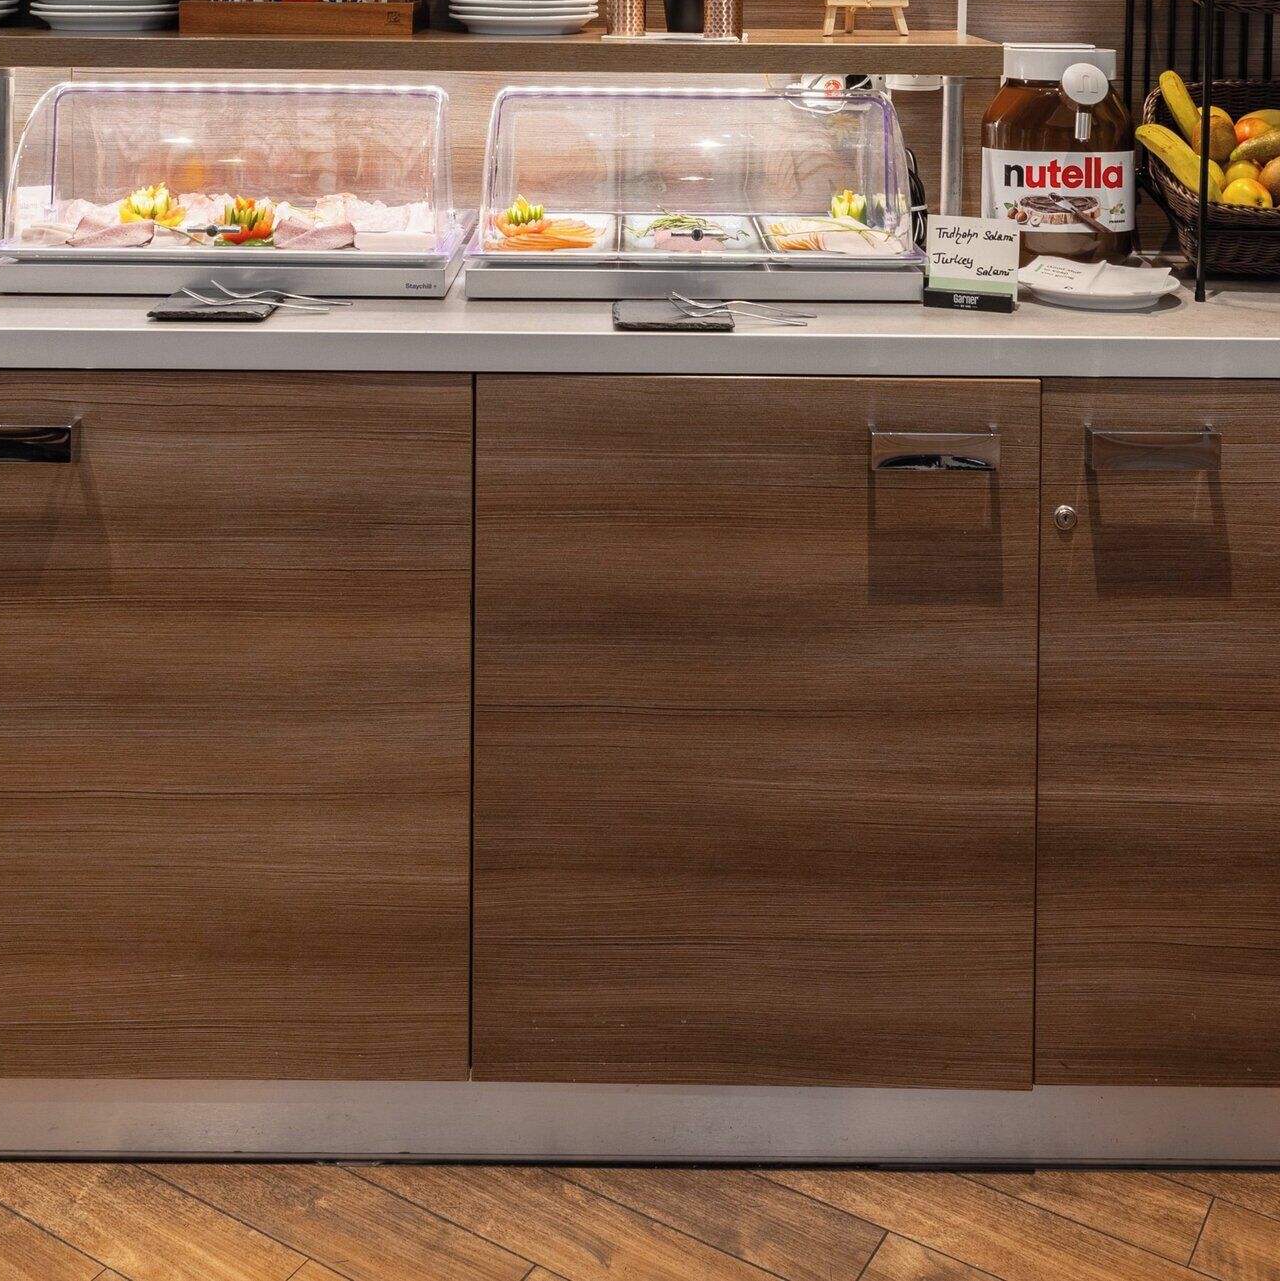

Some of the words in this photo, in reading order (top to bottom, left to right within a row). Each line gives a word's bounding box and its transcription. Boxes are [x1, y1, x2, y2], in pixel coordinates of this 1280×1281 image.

[1004, 156, 1123, 189] nutella
[933, 252, 973, 269] Turkey
[954, 294, 978, 305] Garner
